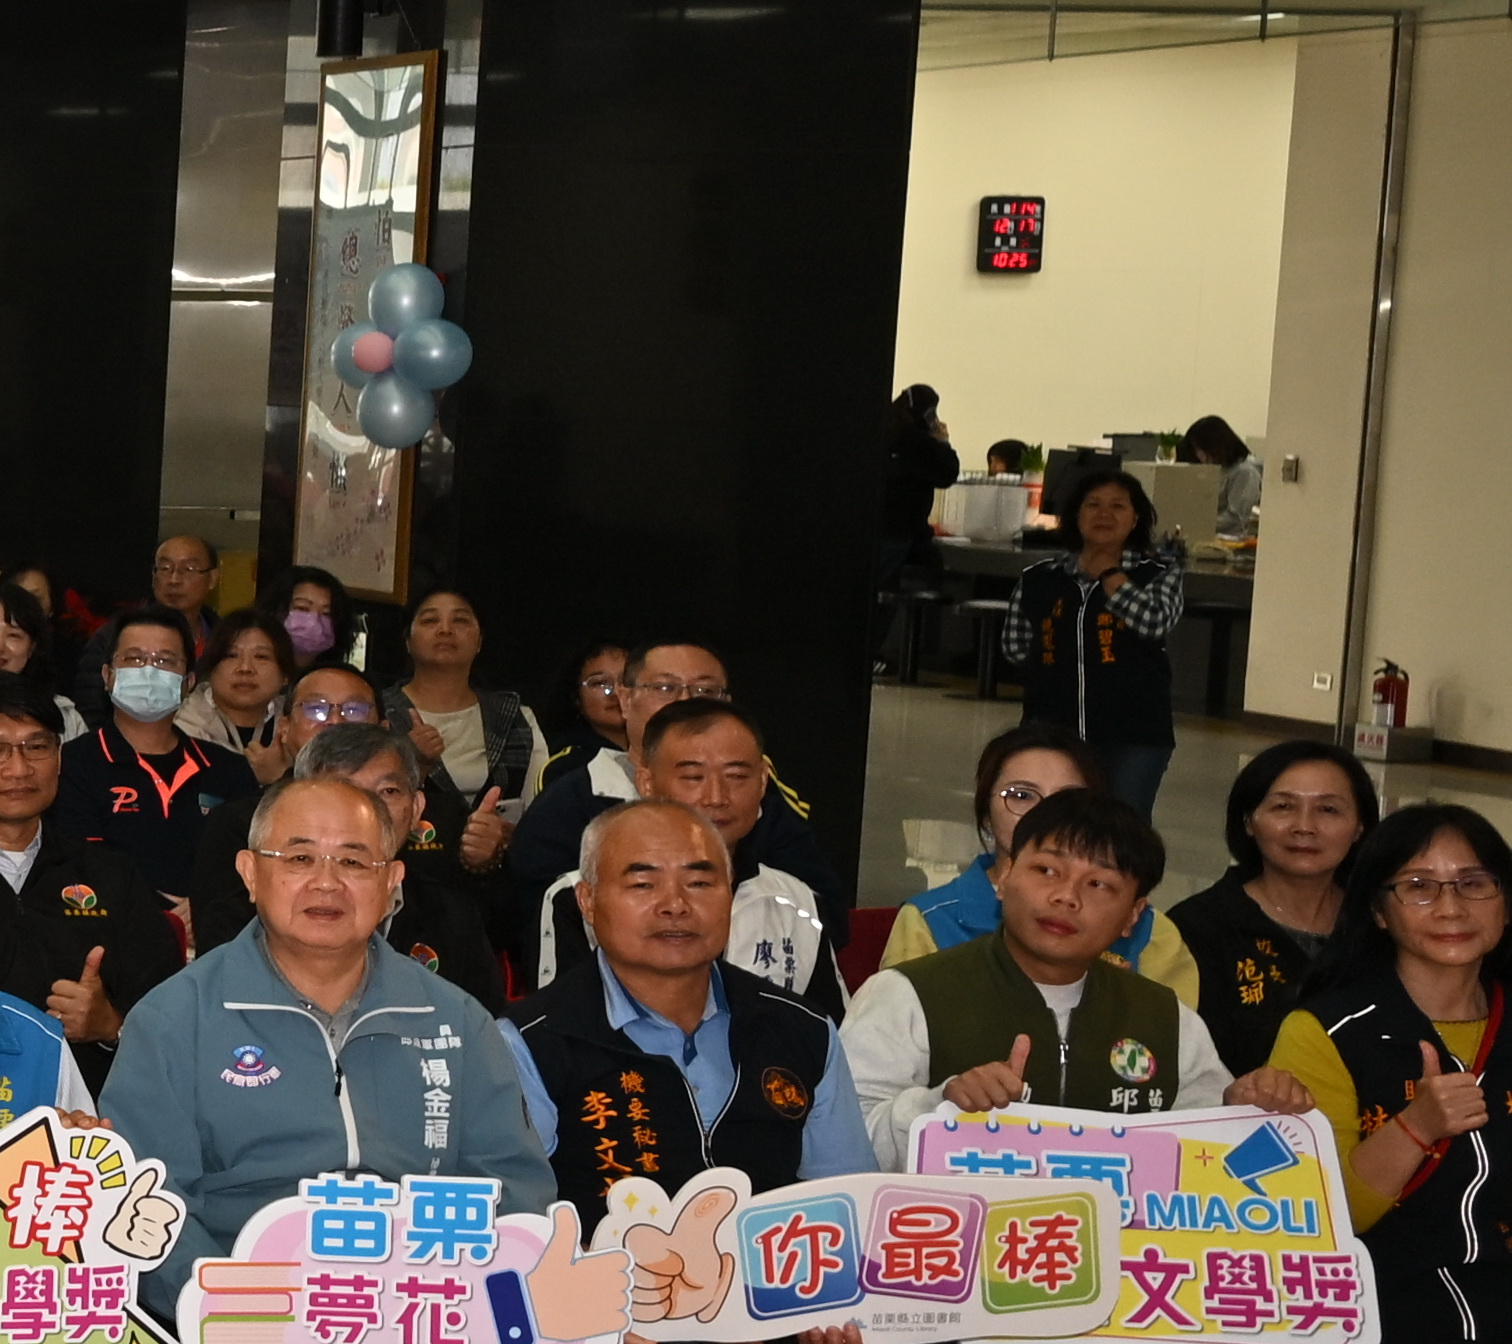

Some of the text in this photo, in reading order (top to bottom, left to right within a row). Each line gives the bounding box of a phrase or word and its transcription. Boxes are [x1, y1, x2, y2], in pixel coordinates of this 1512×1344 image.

[419, 1058, 451, 1150] 楊金福
[1109, 1086, 1140, 1113] 邱
[306, 1176, 499, 1262] 苗栗
[759, 1205, 1081, 1297] 你最棒
[1144, 1193, 1319, 1238] MIAOLI
[871, 1311, 962, 1325] 苗栗縣立圖書館
[1120, 1249, 1362, 1338] 文學獎
